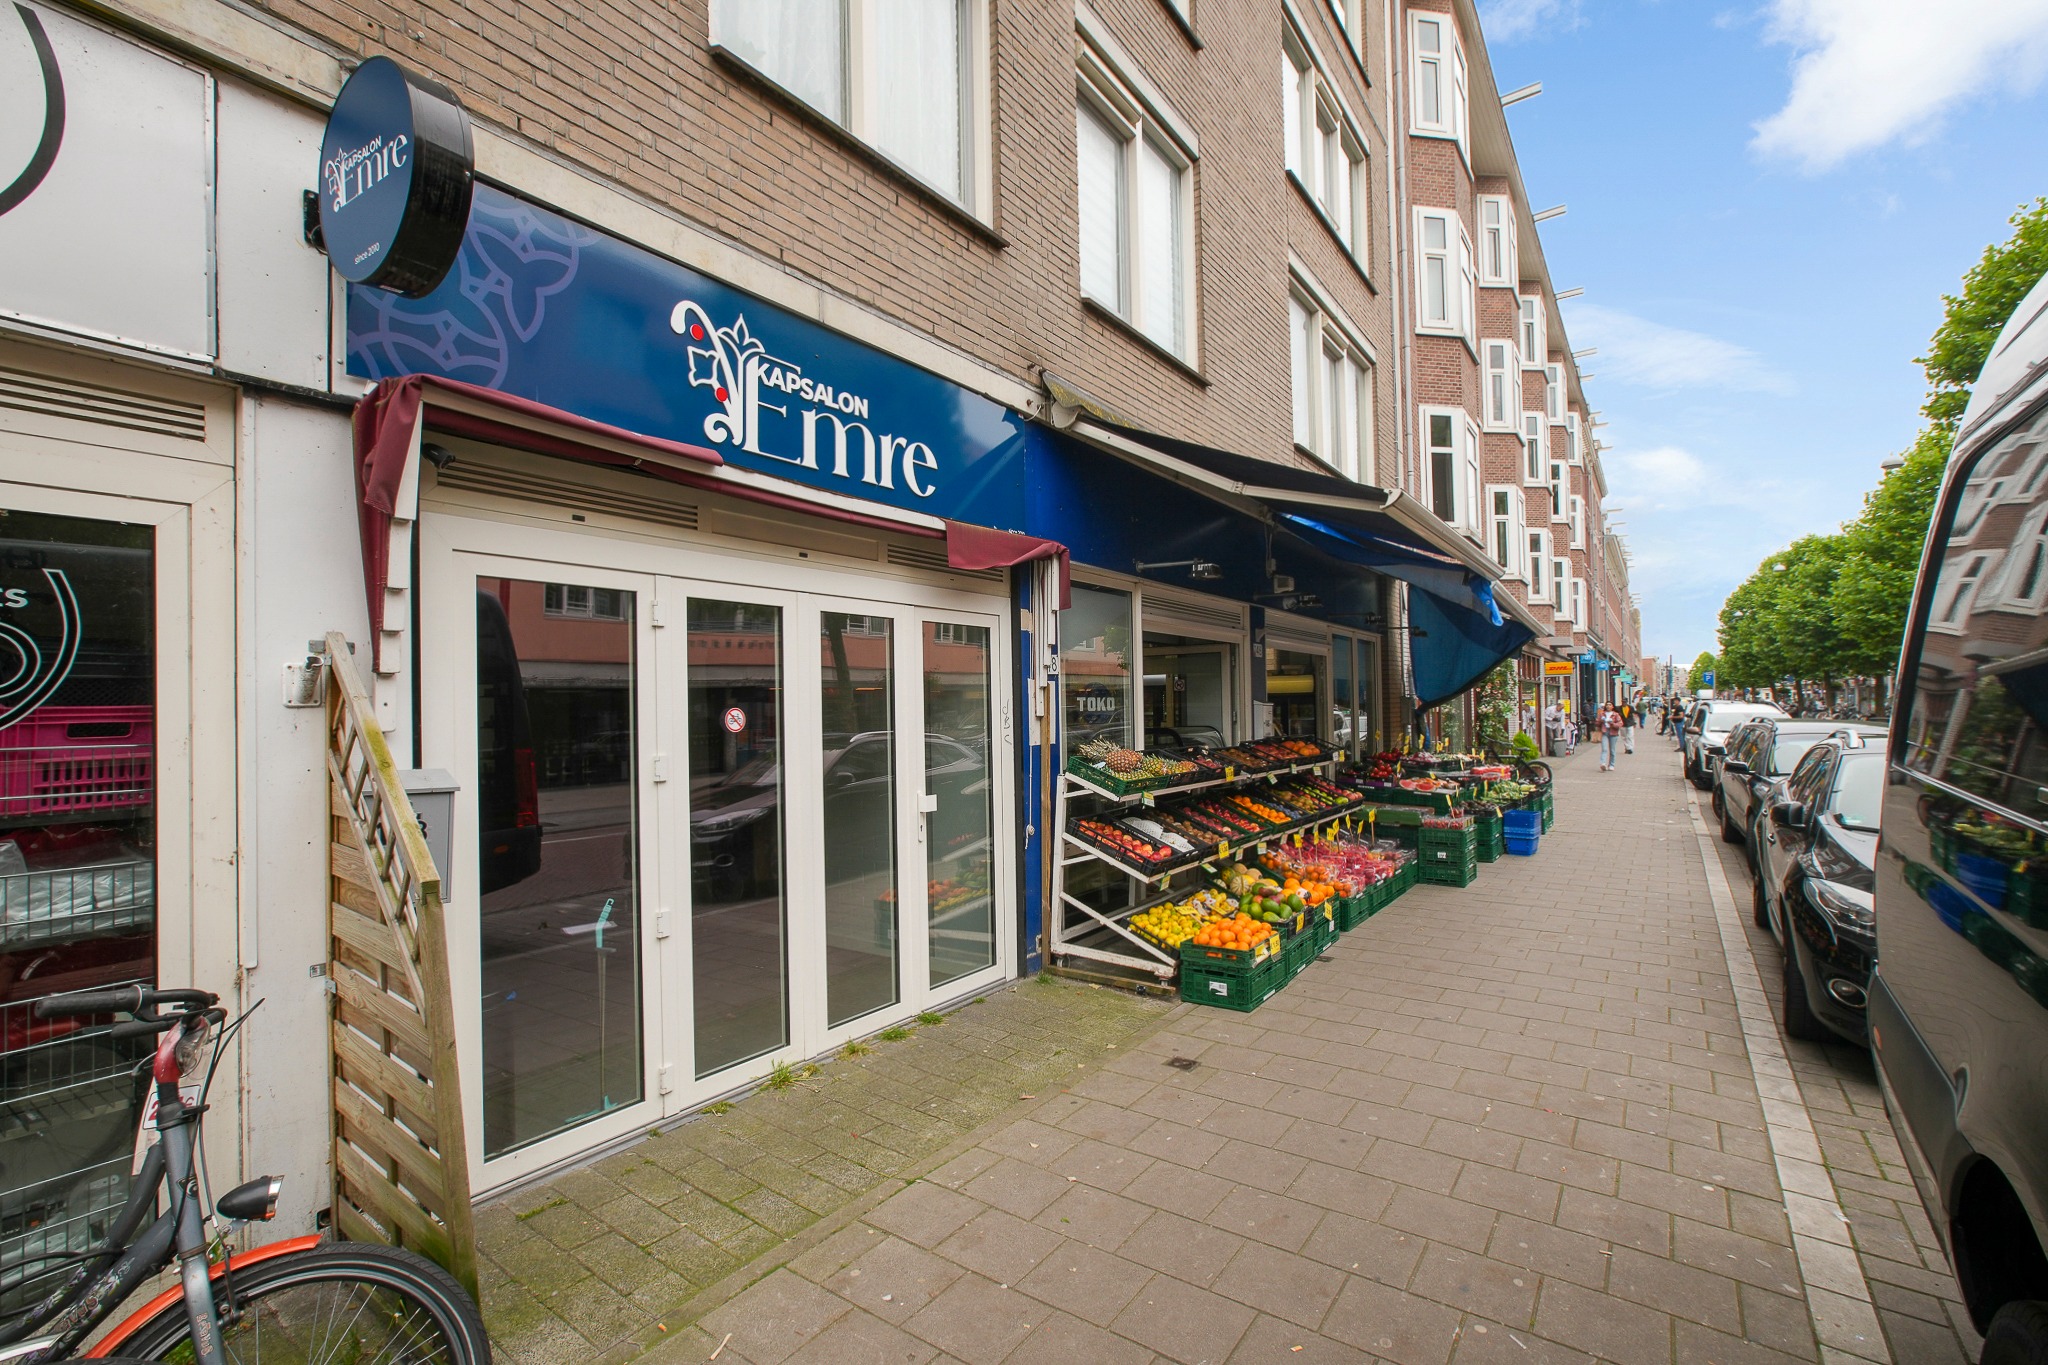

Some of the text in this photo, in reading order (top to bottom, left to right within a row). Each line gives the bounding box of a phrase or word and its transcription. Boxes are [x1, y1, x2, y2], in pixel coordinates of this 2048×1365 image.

[339, 134, 408, 208] Emre
[344, 135, 382, 171] KAPSALON
[354, 252, 368, 265] since
[756, 361, 869, 420] KAPSALON
[741, 354, 939, 498] Emre
[1076, 696, 1116, 712] TOKO
